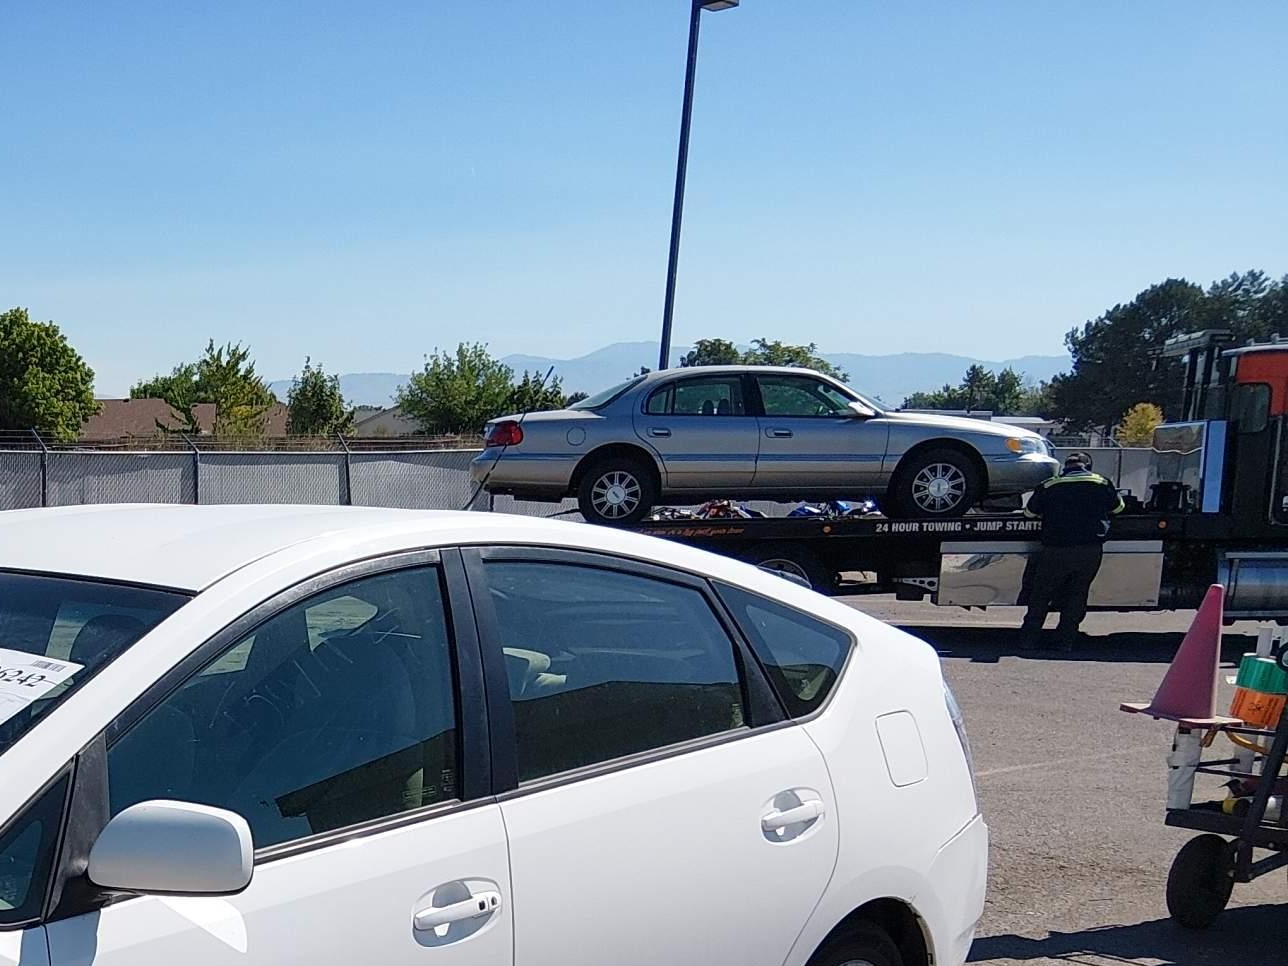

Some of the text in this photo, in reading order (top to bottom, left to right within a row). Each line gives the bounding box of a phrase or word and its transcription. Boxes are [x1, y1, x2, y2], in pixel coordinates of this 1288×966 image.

[876, 521, 889, 532] 24
[891, 521, 919, 532] HOUR
[922, 521, 962, 532] TOWING
[973, 520, 1003, 531] JUMP
